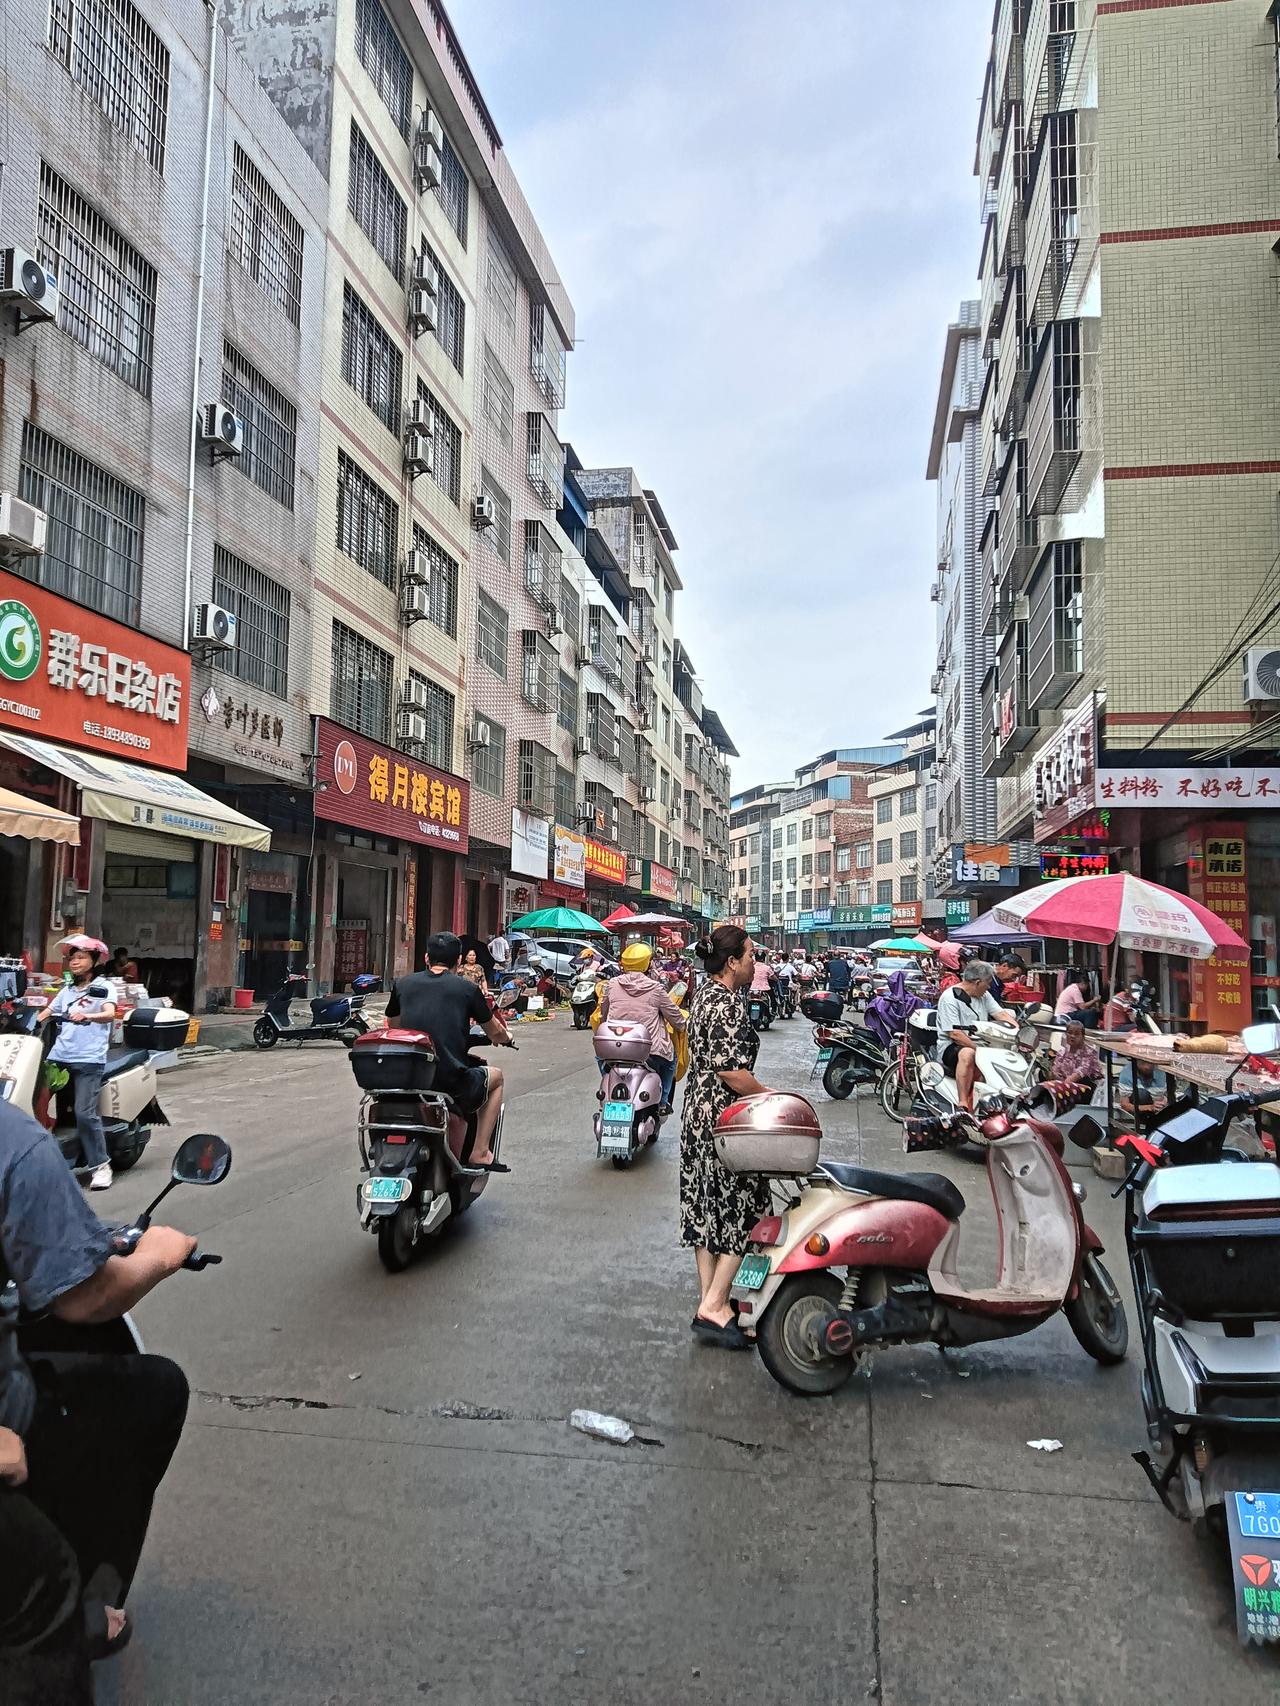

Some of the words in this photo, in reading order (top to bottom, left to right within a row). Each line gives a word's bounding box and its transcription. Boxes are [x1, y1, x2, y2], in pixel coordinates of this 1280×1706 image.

[47, 629, 182, 724] 群乐日杂店
[369, 754, 461, 826] 得月楼宾馆
[1100, 776, 1162, 799] 生料粉
[1208, 842, 1243, 855] 本店
[955, 860, 1000, 881] 住宿
[1208, 859, 1243, 873] 承诺
[1217, 973, 1241, 986] 不好吃
